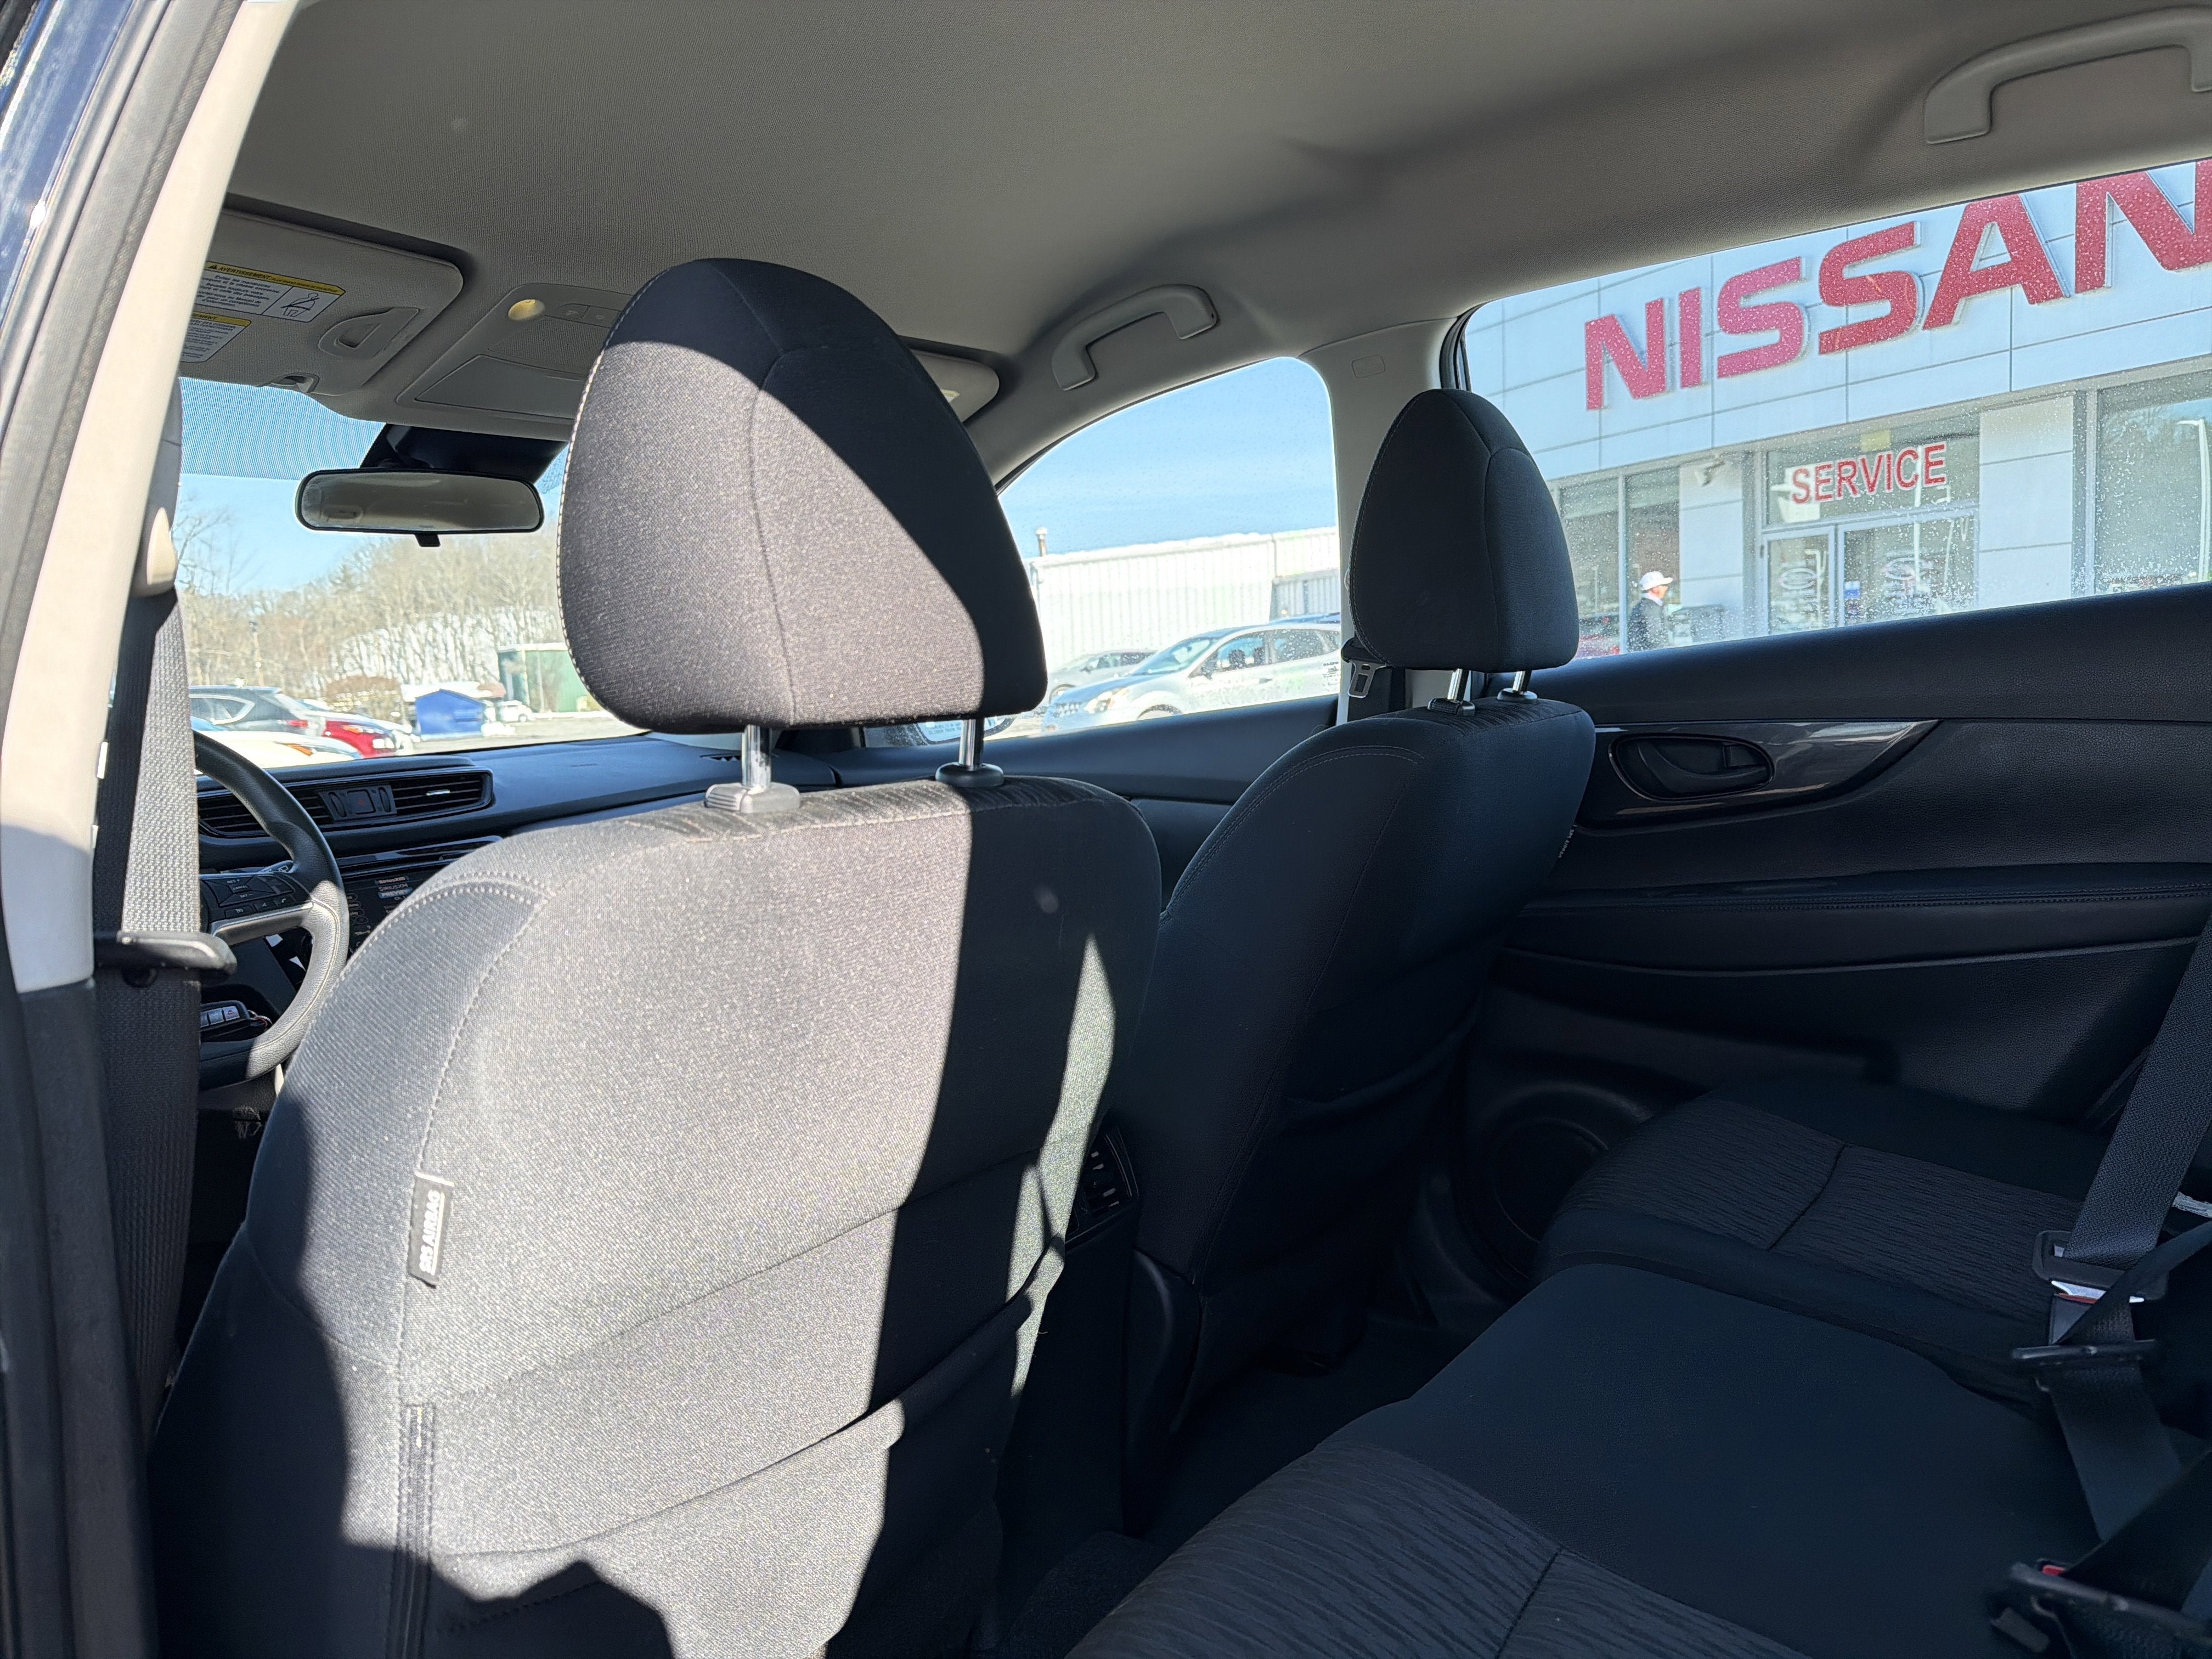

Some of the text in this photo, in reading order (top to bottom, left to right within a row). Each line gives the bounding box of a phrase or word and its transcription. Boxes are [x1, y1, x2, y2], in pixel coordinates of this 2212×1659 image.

[1585, 159, 2212, 411] NISSAN
[1792, 443, 1946, 504] SERVICE
[422, 1189, 441, 1247] AIRBAG
